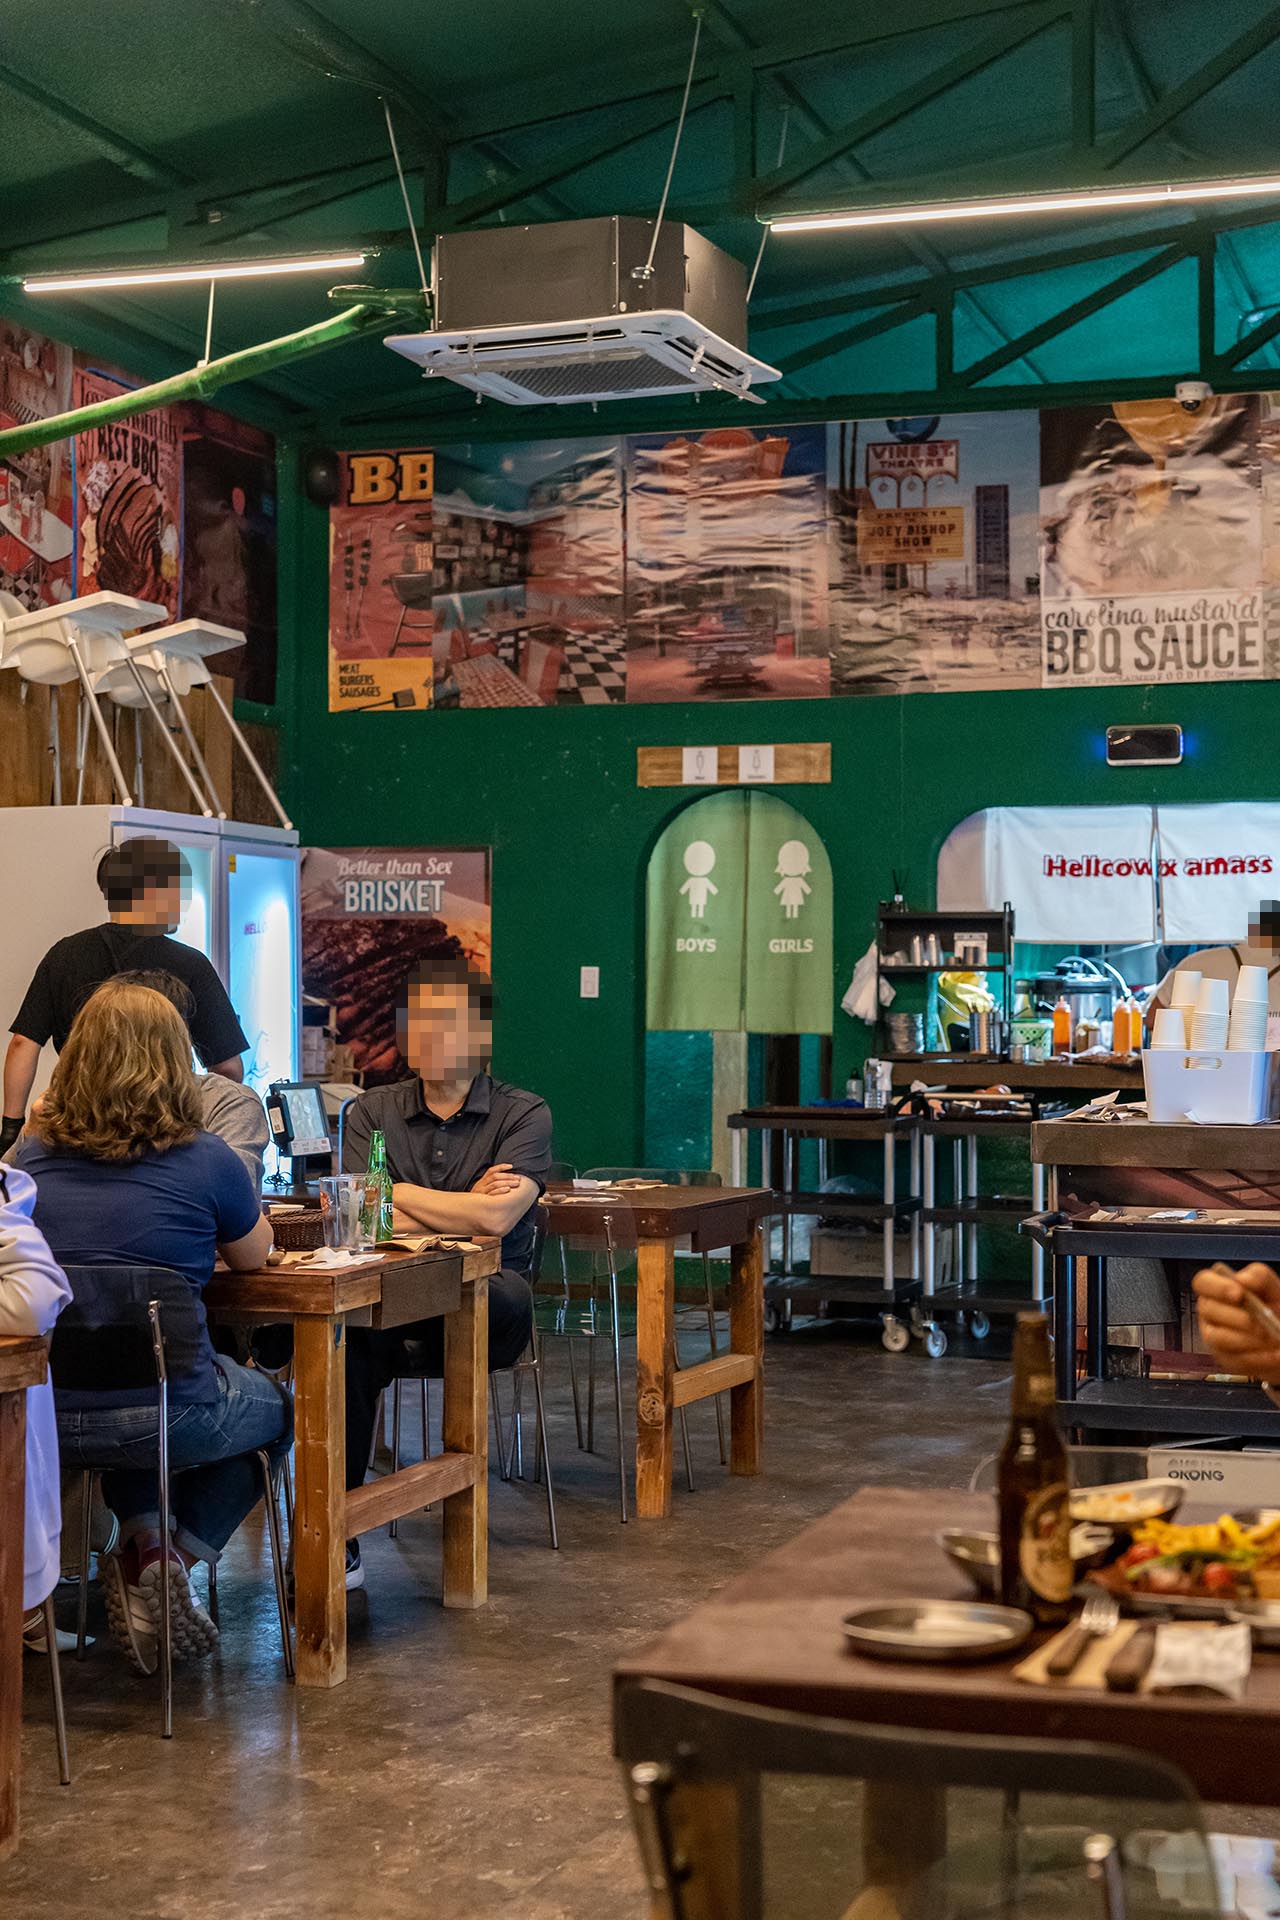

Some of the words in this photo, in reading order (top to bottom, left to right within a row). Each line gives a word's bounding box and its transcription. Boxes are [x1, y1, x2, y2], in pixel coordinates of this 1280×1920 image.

[132, 431, 159, 484] BBQ
[872, 446, 920, 459] VINE
[880, 458, 944, 469] THEATRE
[869, 525, 902, 538] JOEY
[907, 523, 956, 536] BISHOP
[894, 536, 932, 548] SHOW
[1045, 600, 1149, 629] carolina
[1154, 596, 1260, 622] mustard
[1047, 627, 1122, 676] BBQ
[1133, 621, 1260, 672] SAUCE
[338, 663, 360, 674] MEAT
[338, 674, 375, 686] BURGERS
[338, 686, 382, 698] SAUSAGES
[337, 859, 383, 876] Better
[386, 859, 422, 876] than
[425, 857, 453, 875] Sex
[1183, 855, 1273, 876] amass
[344, 880, 445, 913] BRISKET
[676, 938, 717, 953] BOYS
[769, 938, 814, 953] GIRLS
